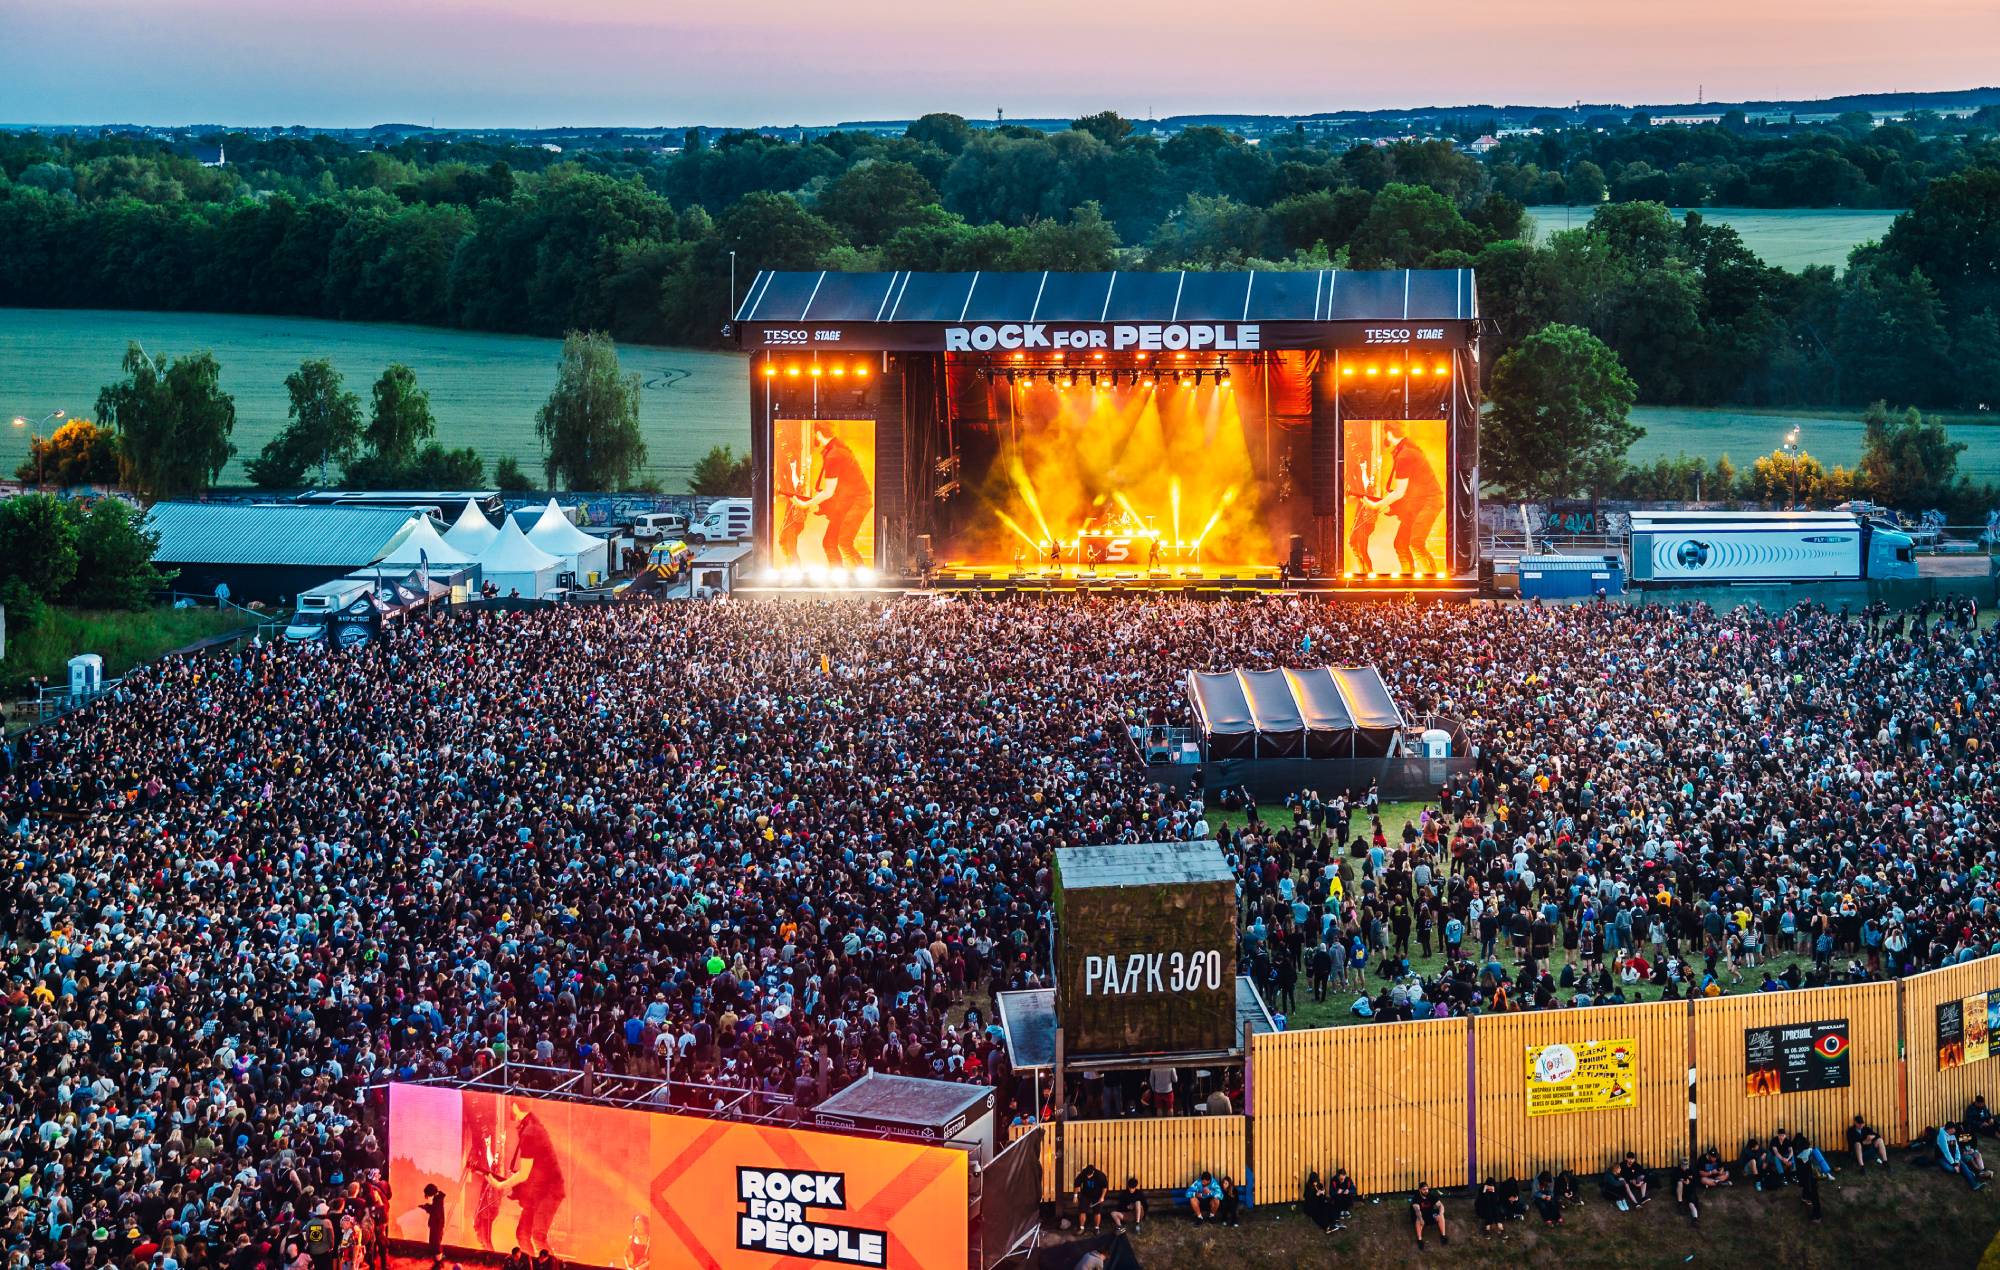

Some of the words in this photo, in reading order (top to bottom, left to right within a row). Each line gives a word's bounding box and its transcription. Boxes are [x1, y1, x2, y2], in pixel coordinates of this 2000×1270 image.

[764, 330, 808, 340] TESCO
[815, 330, 841, 340] STAGE
[945, 324, 1051, 351] ROCK
[1053, 330, 1107, 349] FOR
[1113, 324, 1260, 350] PEOPLE
[1365, 329, 1410, 338] TESCO
[1416, 329, 1444, 339] STAGE
[1086, 953, 1164, 995] PARK
[1170, 950, 1221, 992] 360
[944, 1119, 966, 1139] BESTCONT
[742, 1170, 843, 1205] ROCK
[750, 1199, 802, 1223] FOR
[742, 1217, 882, 1264] PEOPLE
